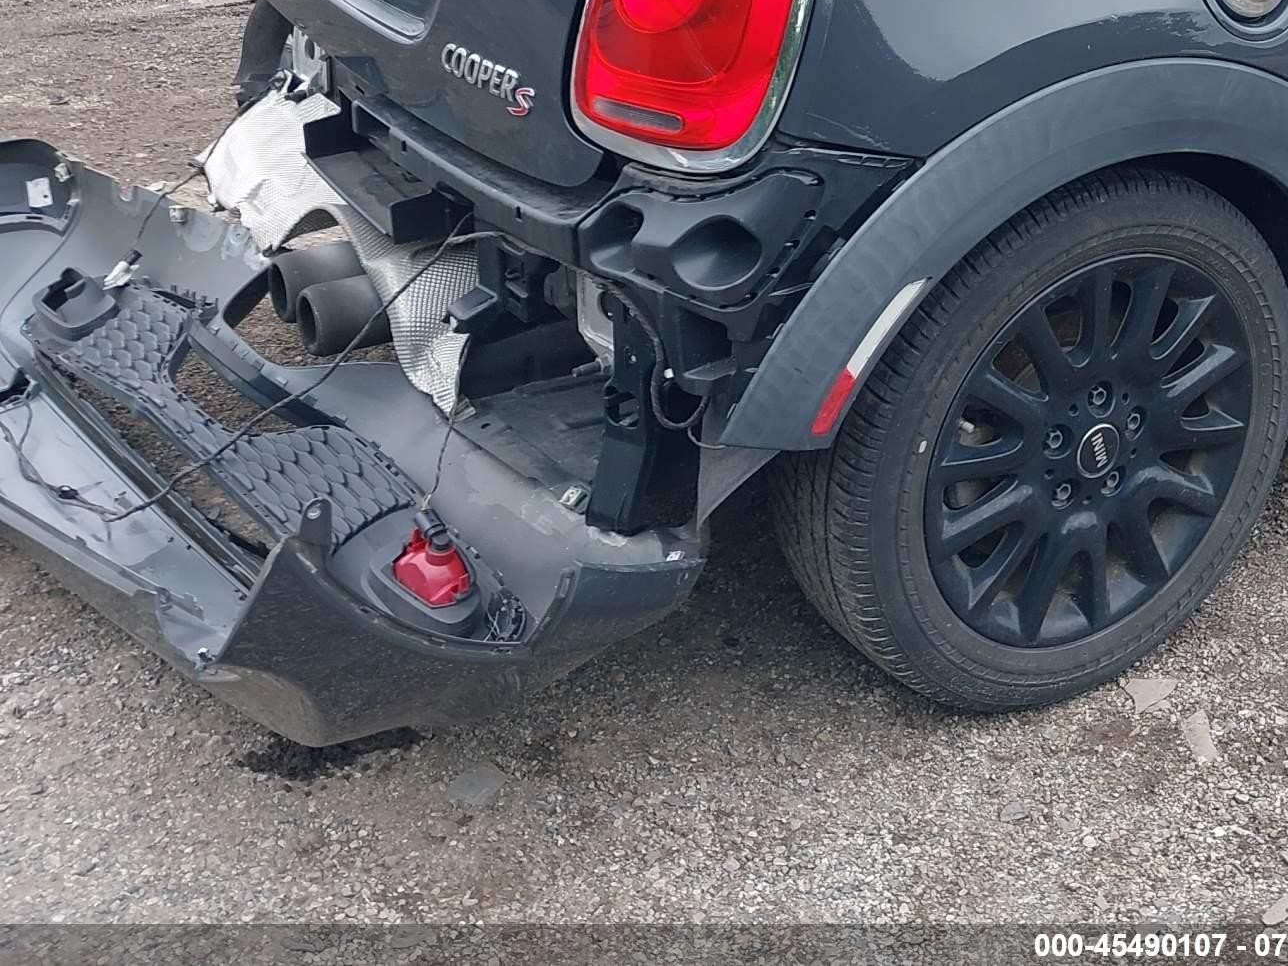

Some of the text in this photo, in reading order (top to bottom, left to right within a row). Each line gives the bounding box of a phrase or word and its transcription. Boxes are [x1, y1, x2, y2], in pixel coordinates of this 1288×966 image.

[441, 43, 536, 117] COOPER S
[1090, 432, 1109, 469] MINI
